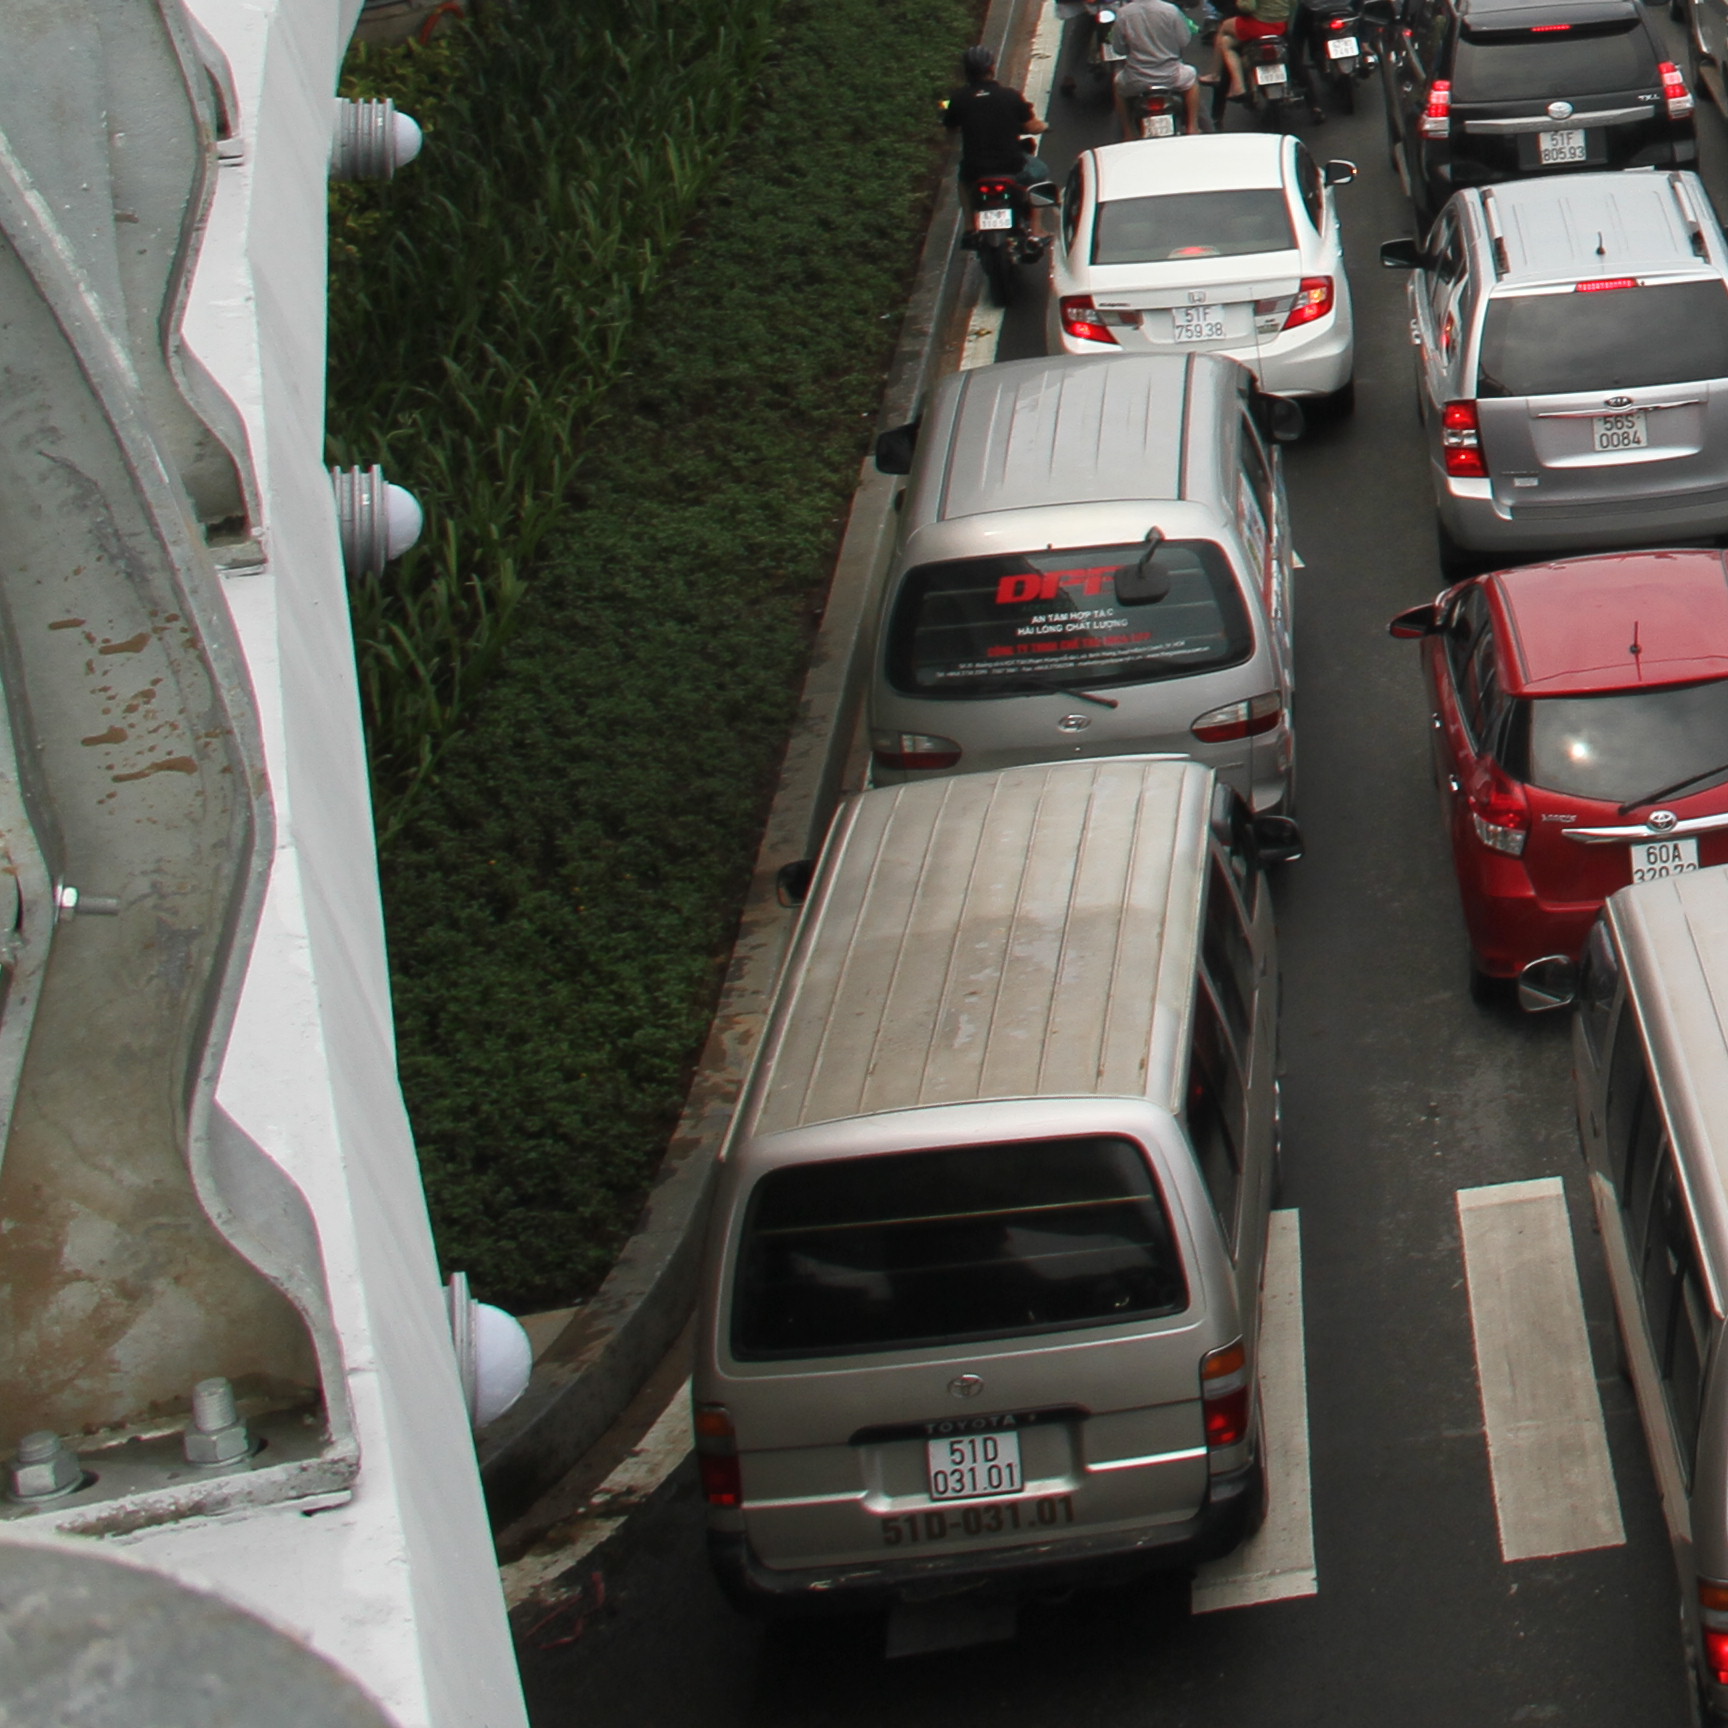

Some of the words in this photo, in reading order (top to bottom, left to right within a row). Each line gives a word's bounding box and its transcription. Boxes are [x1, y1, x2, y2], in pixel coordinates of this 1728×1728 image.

[1551, 131, 1574, 147] 51F
[1542, 146, 1584, 162] 805.93
[1184, 304, 1211, 323] 51F
[1175, 322, 1224, 342] 759.38
[1603, 414, 1635, 431] 56S
[1599, 429, 1642, 450] 0084
[924, 1414, 1017, 1434] TOYOTA
[948, 1435, 999, 1465] 51D
[933, 1461, 1016, 1496] 031.01
[882, 1495, 1076, 1547] 51D-031.01
